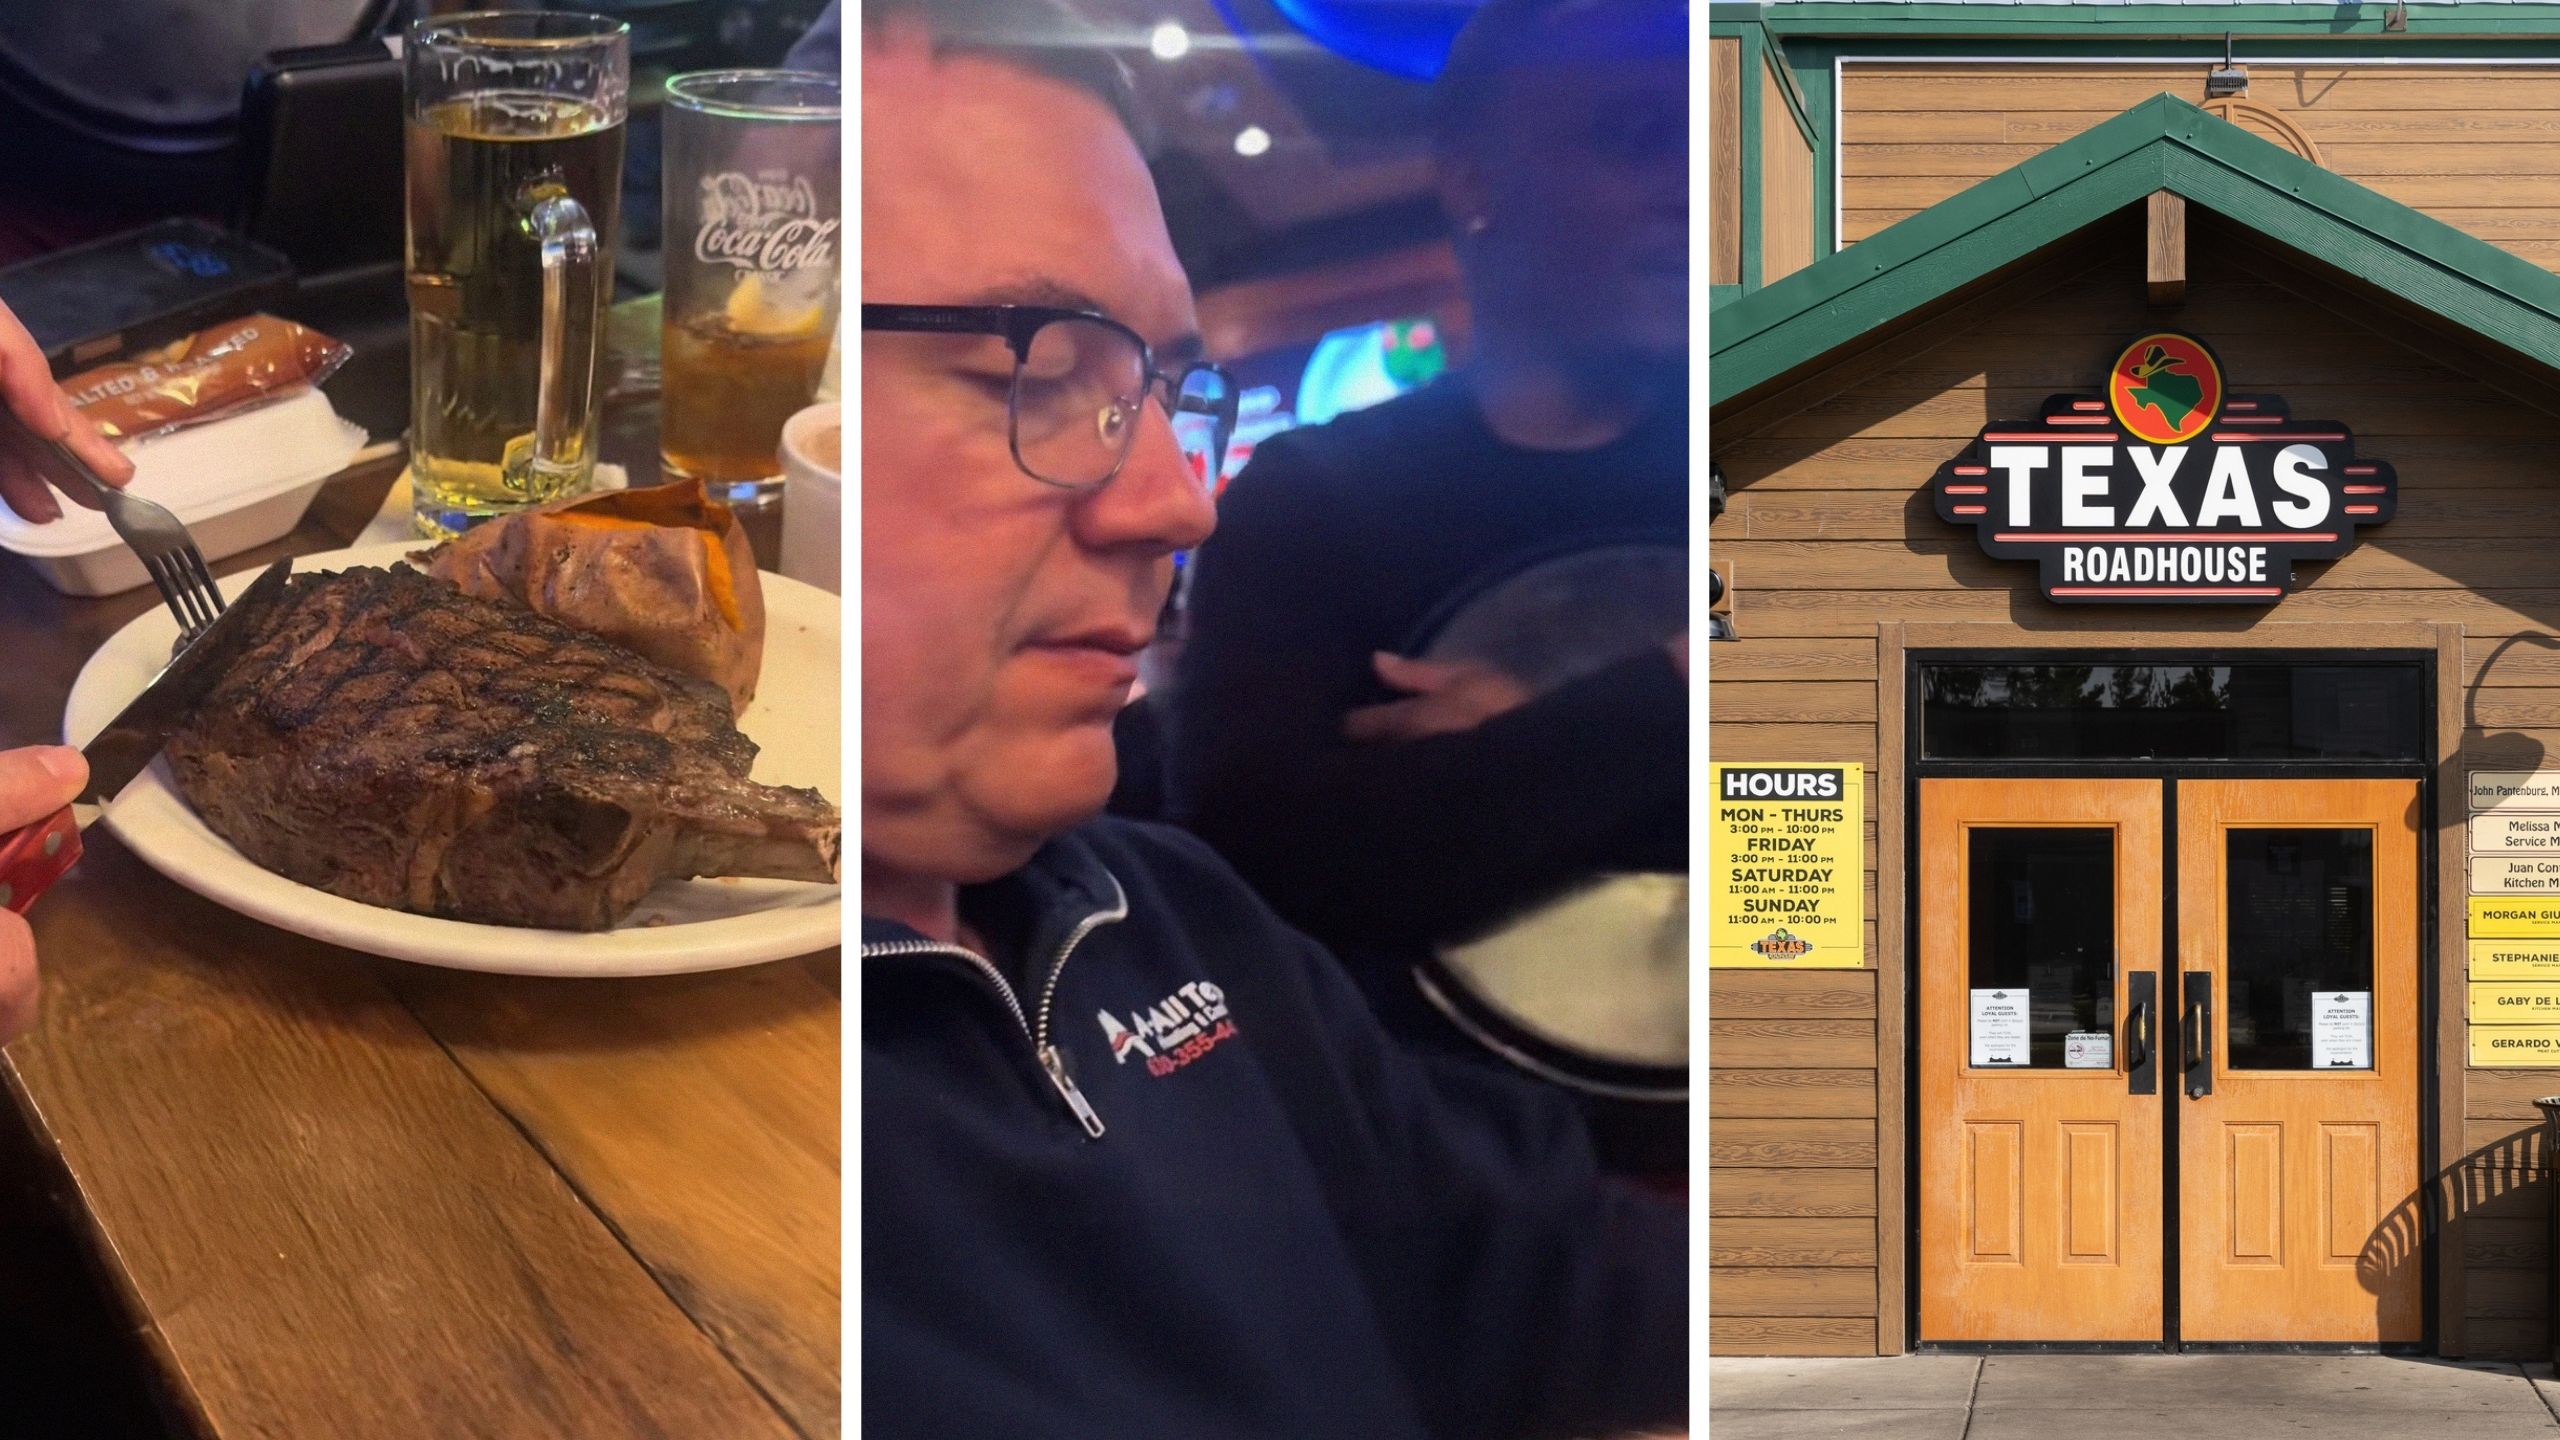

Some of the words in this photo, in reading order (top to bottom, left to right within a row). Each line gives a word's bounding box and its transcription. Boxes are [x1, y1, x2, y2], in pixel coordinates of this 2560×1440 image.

[694, 217, 841, 272] Coca-Cola
[68, 375, 137, 406] ALTED
[1990, 443, 2331, 529] TEXAS
[2063, 546, 2267, 583] ROADHOUSE
[1726, 773, 1837, 797] HOURS
[2473, 785, 2494, 796] John
[1721, 808, 1764, 822] MON
[1781, 808, 1844, 822] THURS
[1730, 824, 1758, 834] 3:00
[1786, 824, 1820, 834] 10:00
[2509, 821, 2550, 831] Melissa
[1747, 838, 1816, 851] FRIDAY
[2505, 836, 2546, 846] Service
[1730, 854, 1758, 863] 3:00
[1788, 854, 1818, 863] 11:00
[2508, 862, 2534, 873] Juan
[1731, 868, 1833, 882] SATURDAY
[2504, 878, 2545, 888] Kitchen
[1729, 885, 1759, 894] 11:00
[1788, 885, 1819, 894] 11:00
[1743, 899, 1820, 912] SUNDAY
[1728, 915, 1758, 924] 11:00
[1787, 915, 1821, 924] 10:00
[2483, 910, 2536, 920] MORGAN
[1759, 940, 1804, 953] TEXAS
[2492, 953, 2559, 962] STEPHANIE
[2497, 996, 2531, 1005] GABY
[2535, 996, 2551, 1005] DE
[2491, 1039, 2551, 1048] GERARDO
